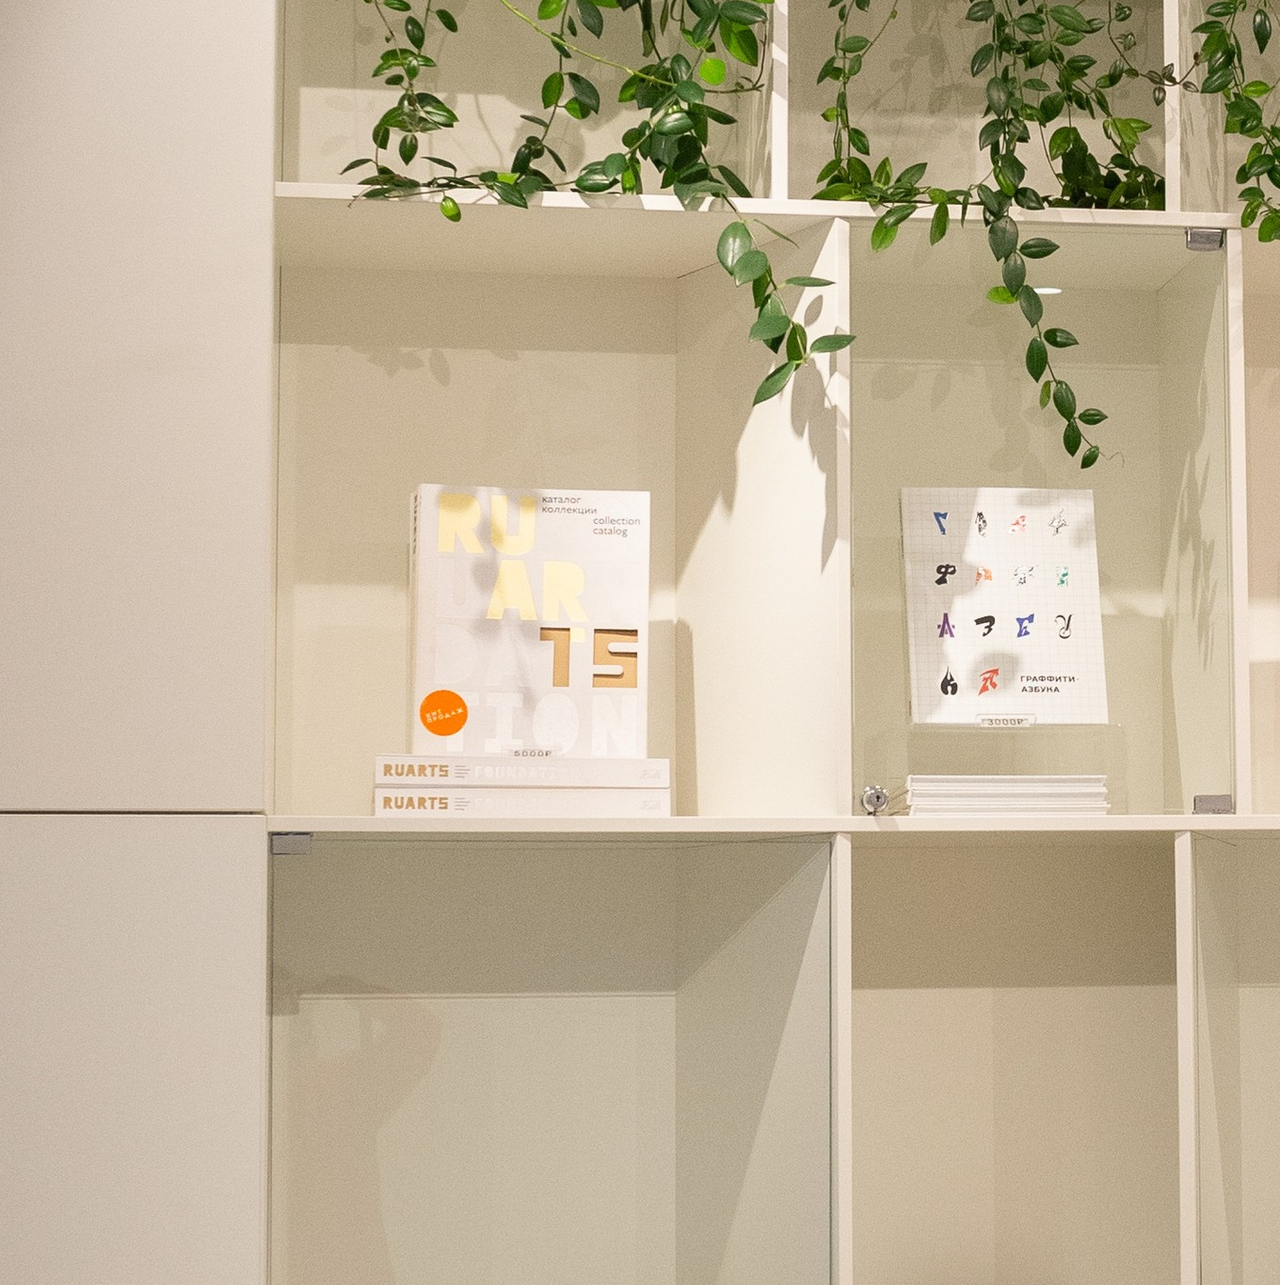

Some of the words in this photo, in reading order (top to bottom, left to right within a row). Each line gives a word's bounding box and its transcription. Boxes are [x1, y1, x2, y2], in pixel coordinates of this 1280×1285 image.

[541, 496, 581, 504] каталог
[541, 506, 597, 515] коллекции
[437, 492, 537, 555] RU
[593, 516, 641, 526] collection
[593, 526, 628, 538] catalog
[486, 559, 590, 621] AR
[1021, 685, 1060, 693] АЗБУКА
[383, 763, 449, 778] RUARTS
[383, 796, 449, 810] RUARTS
